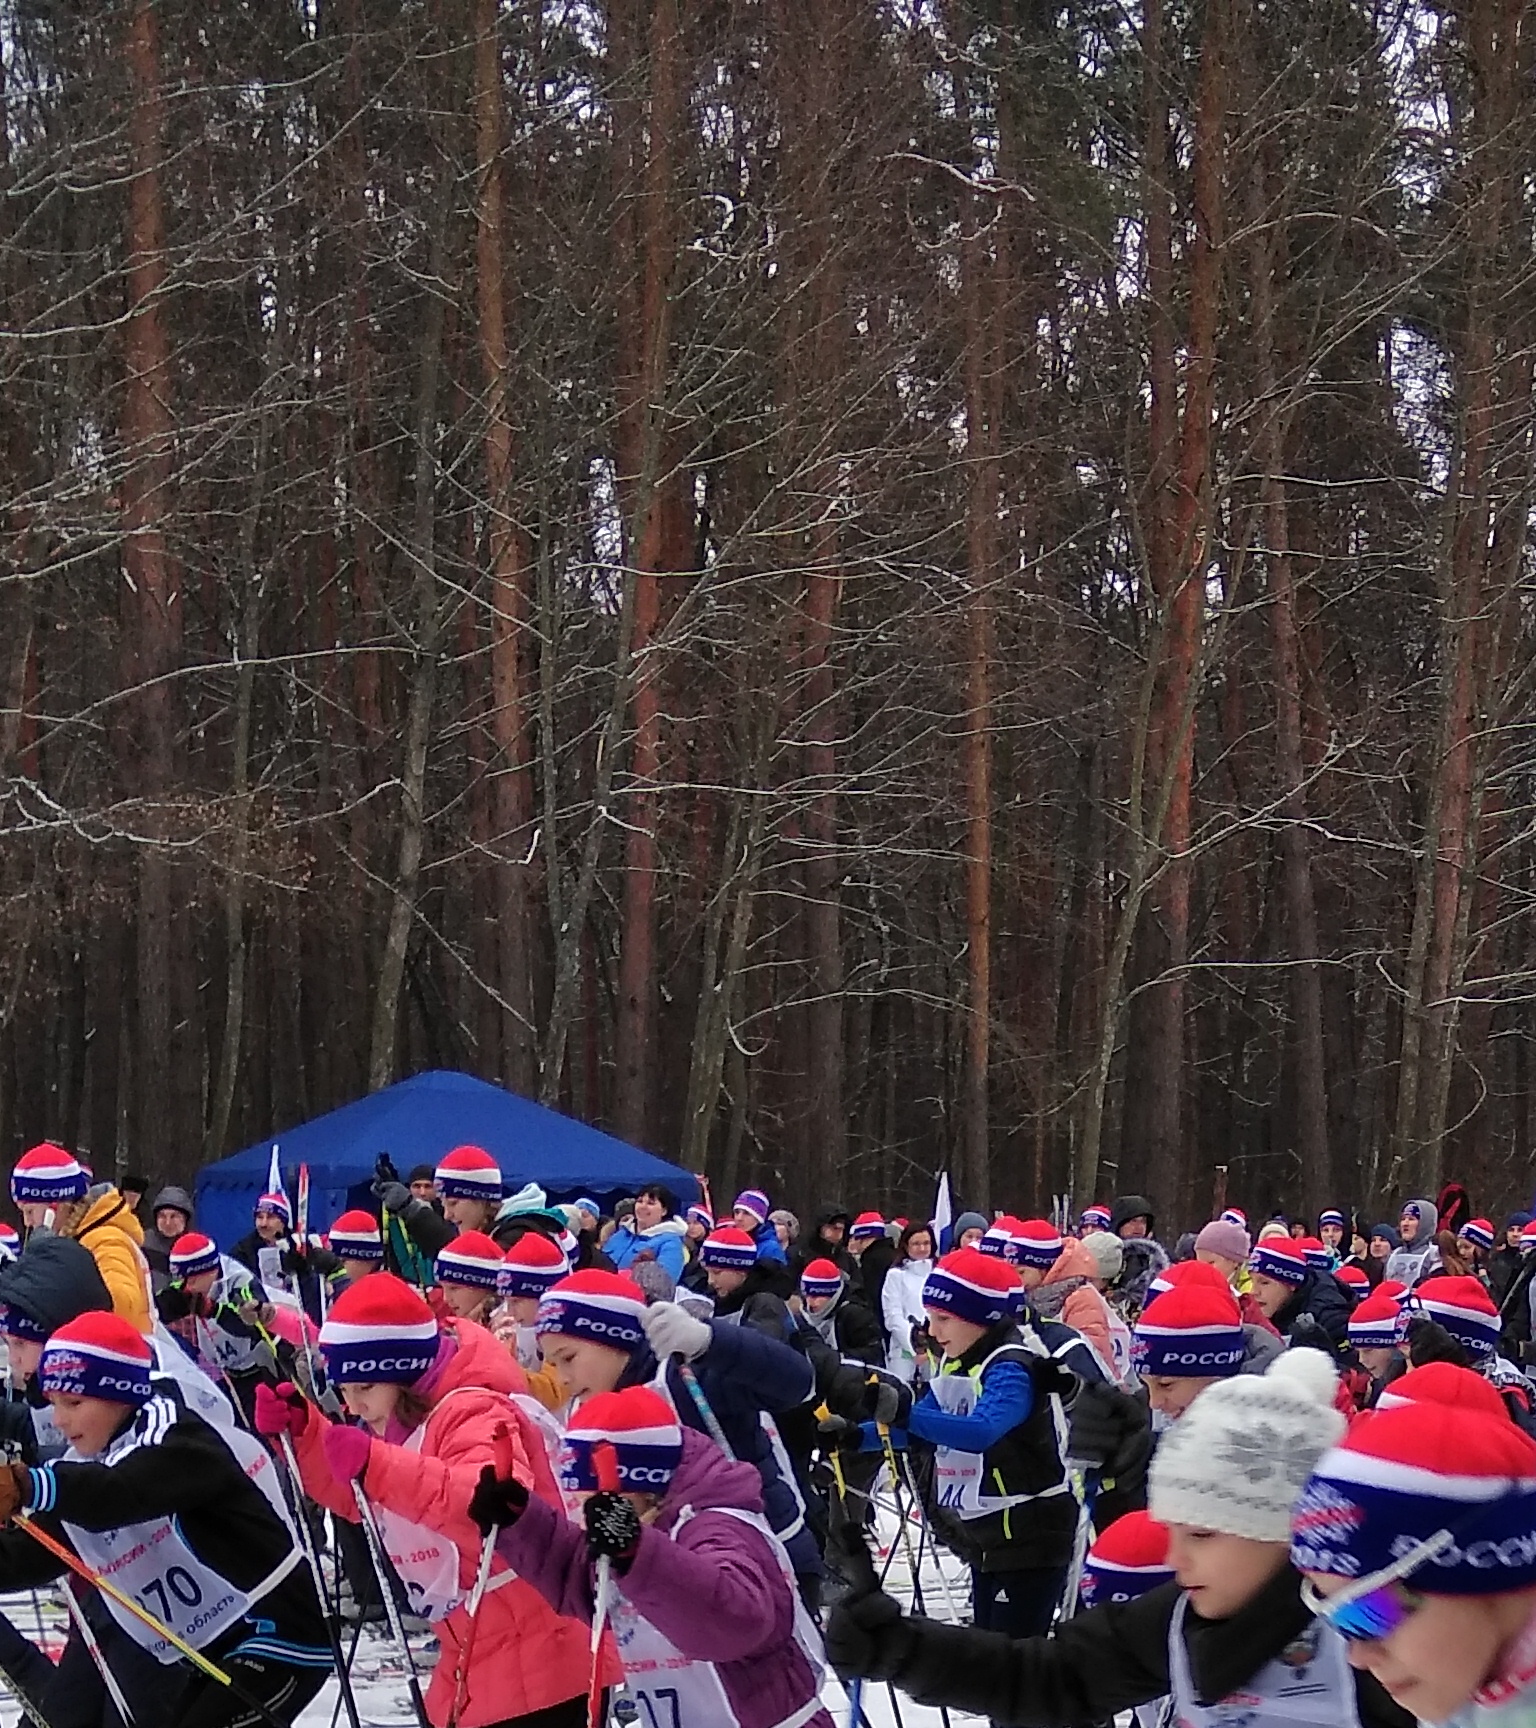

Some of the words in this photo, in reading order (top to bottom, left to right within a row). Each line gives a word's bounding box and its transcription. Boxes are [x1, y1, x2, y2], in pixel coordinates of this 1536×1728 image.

[21, 1185, 76, 1198] РОССИИ
[42, 1377, 86, 1394] 2018
[590, 1466, 672, 1485] ОССИ
